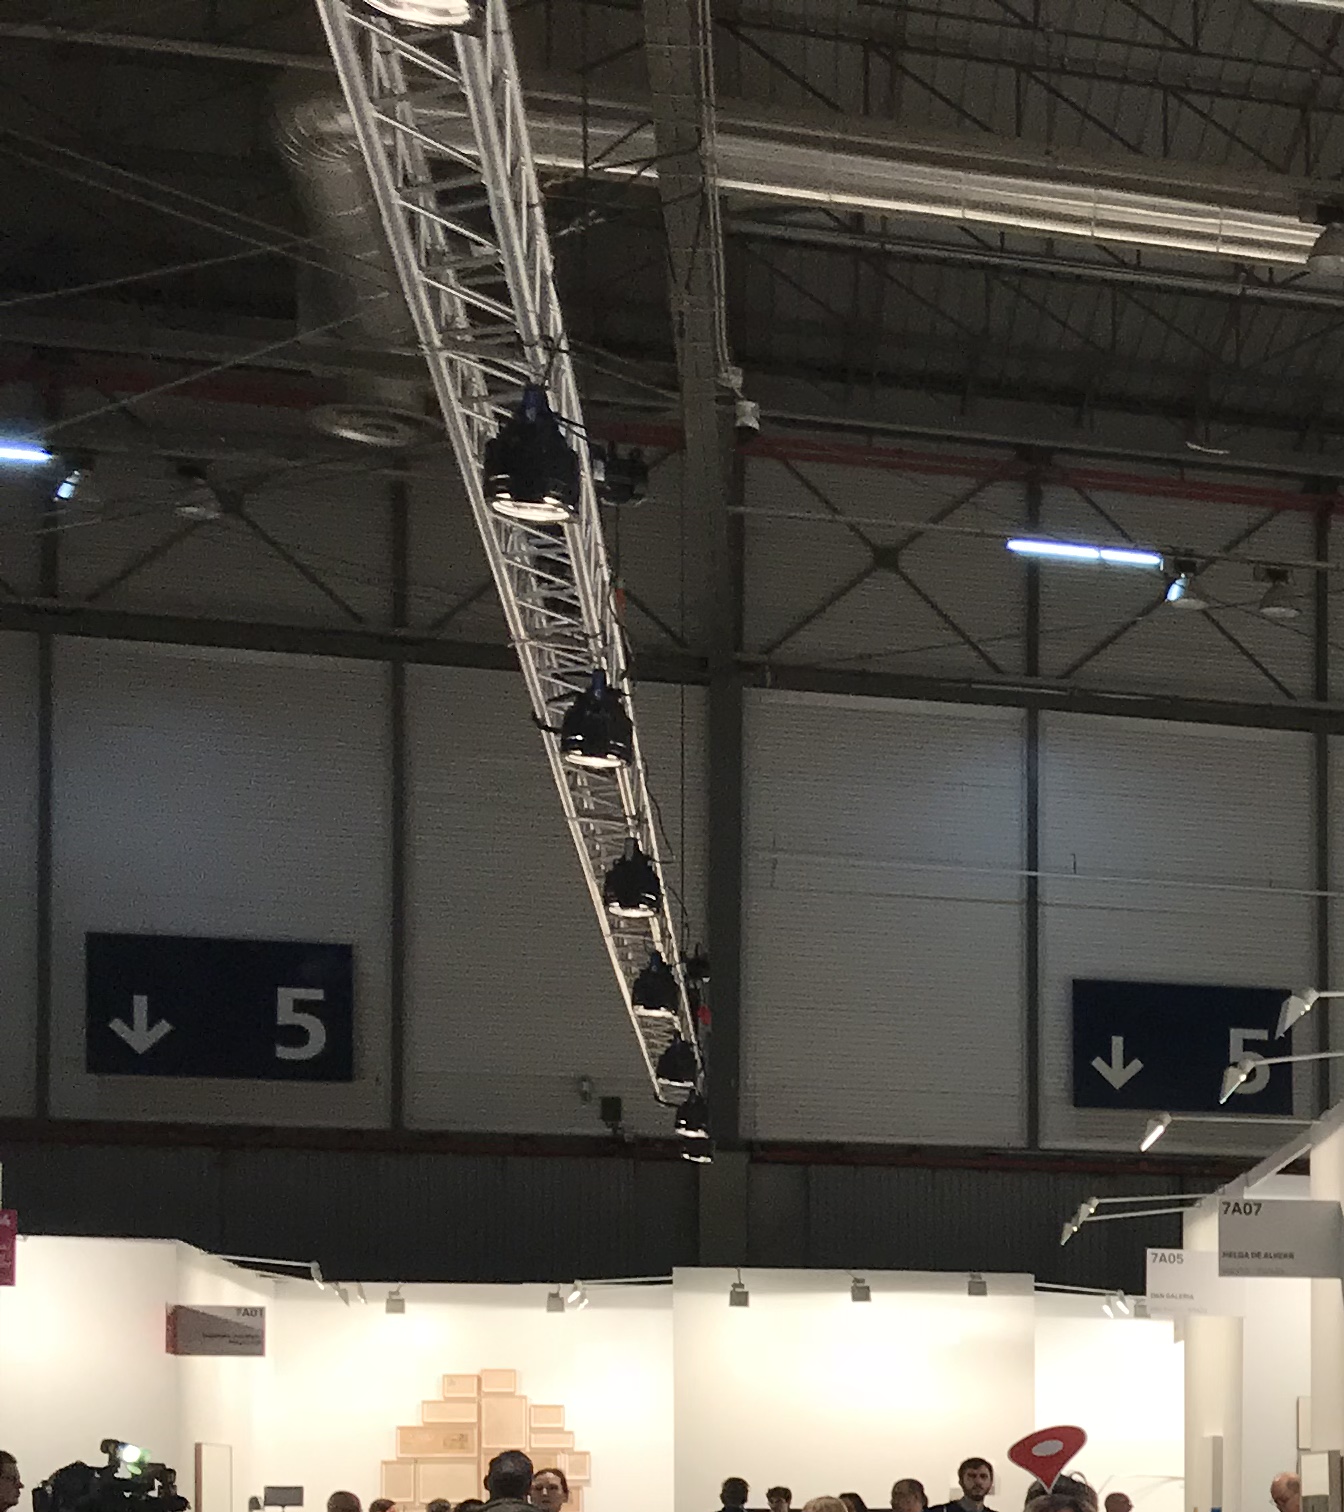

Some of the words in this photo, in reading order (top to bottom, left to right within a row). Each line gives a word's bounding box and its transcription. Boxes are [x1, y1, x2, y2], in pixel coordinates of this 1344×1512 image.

[275, 986, 327, 1061] 5
[1229, 1027, 1271, 1095] 5
[1222, 1201, 1263, 1216] 7A07
[1150, 1252, 1184, 1265] 7A05
